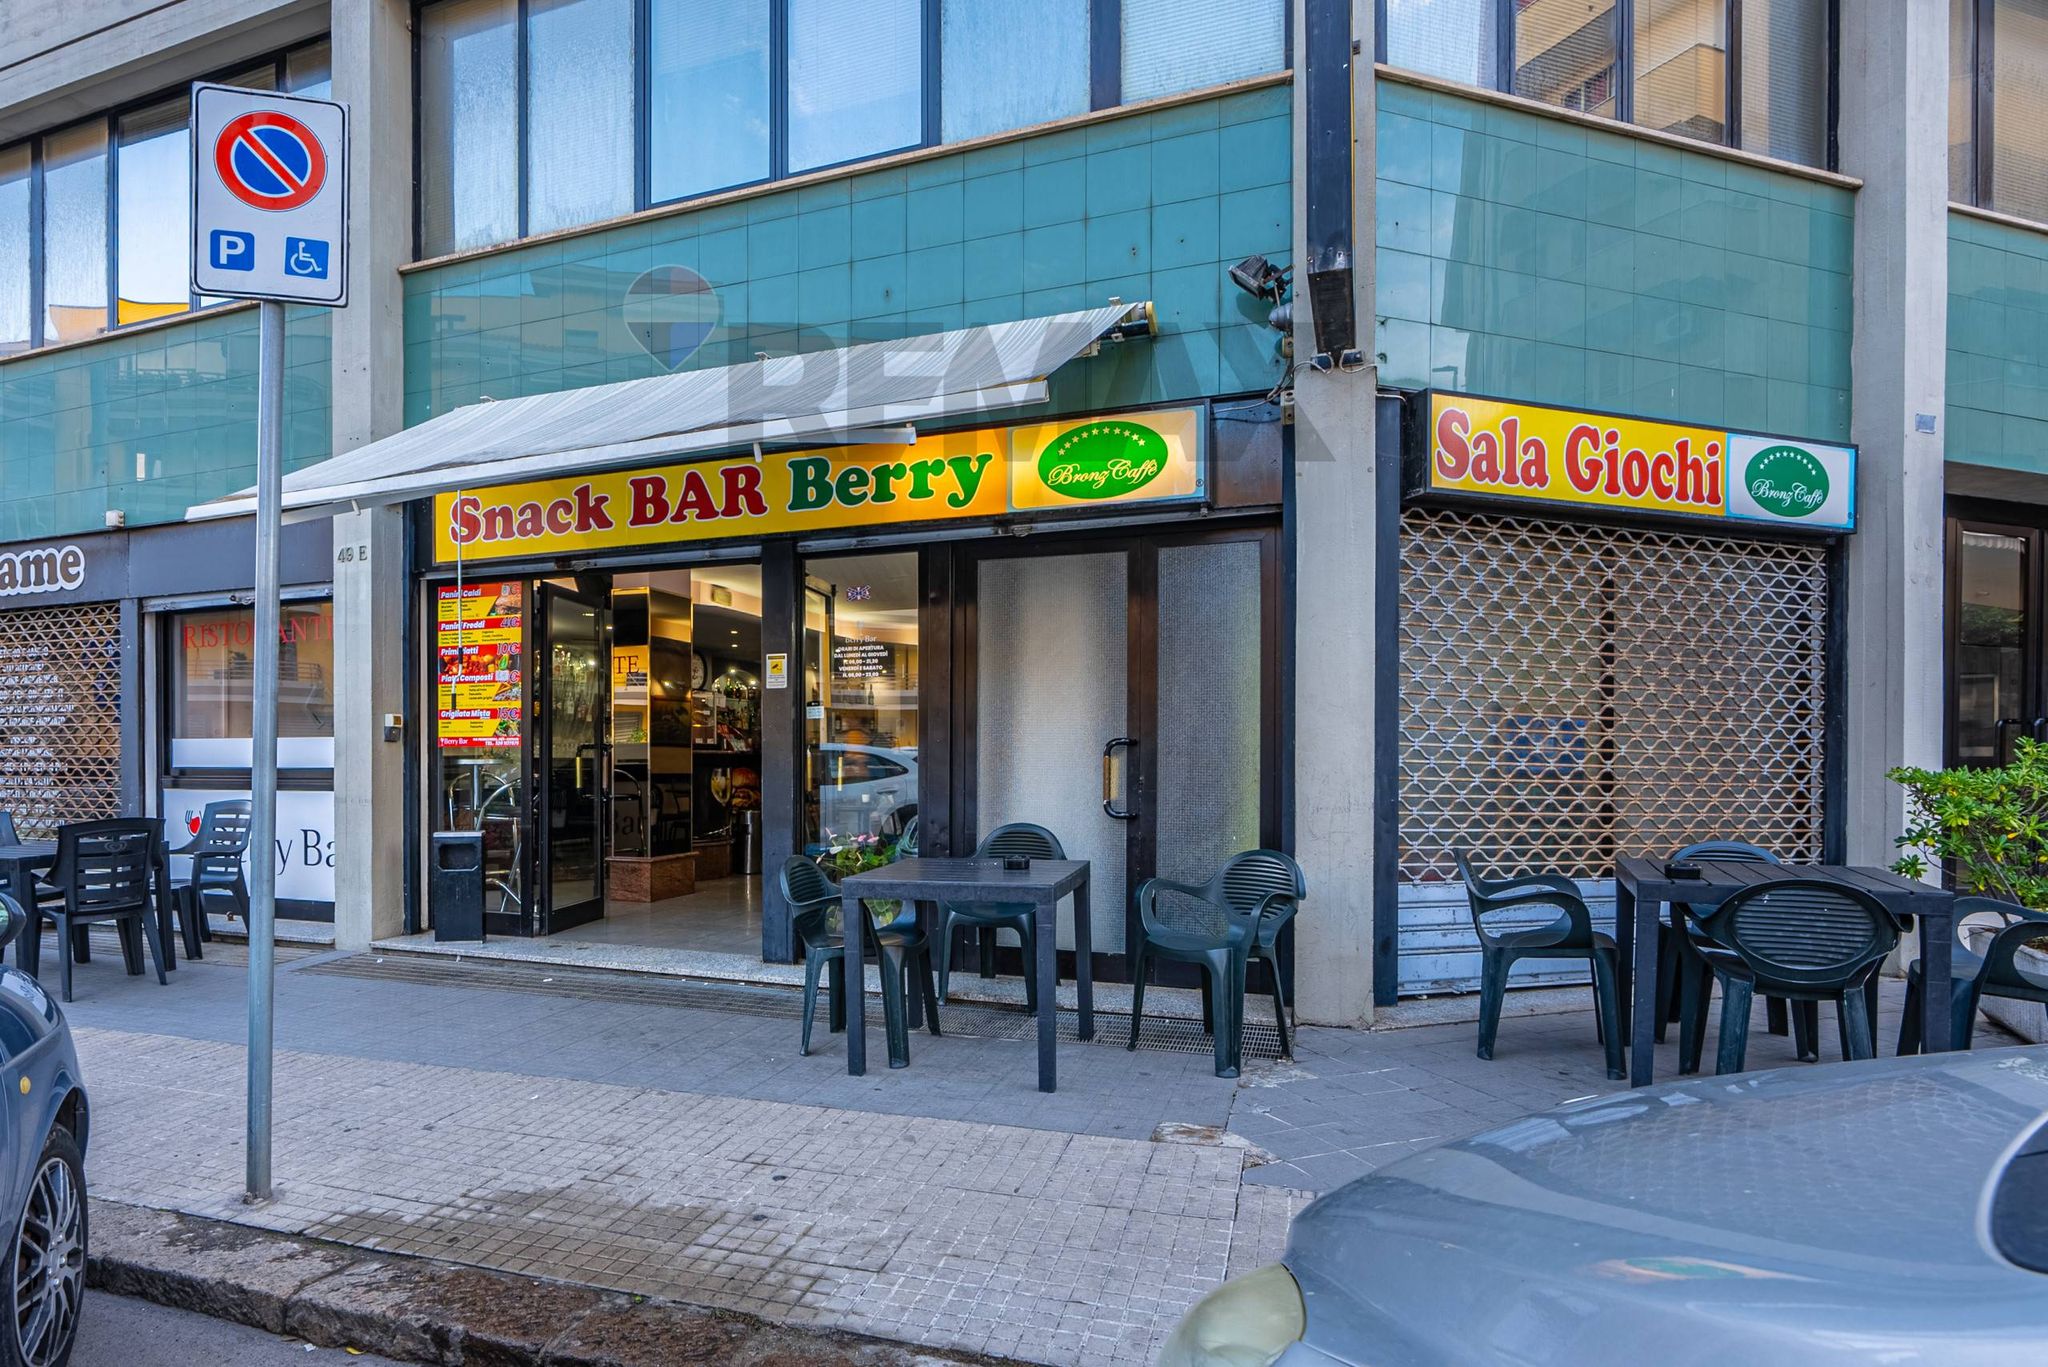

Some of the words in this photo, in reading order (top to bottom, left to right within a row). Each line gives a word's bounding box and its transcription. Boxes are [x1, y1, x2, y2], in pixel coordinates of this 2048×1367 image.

[219, 235, 245, 264] P
[1434, 407, 1549, 489] Sala
[1565, 424, 1722, 507] Giochi
[1047, 463, 1109, 489] Bronz
[450, 483, 615, 544] Snack
[628, 464, 769, 528] BAR
[787, 453, 993, 511] Berry
[1751, 478, 1793, 507] Bronz
[337, 546, 354, 563] 49
[359, 545, 368, 561] E
[463, 588, 482, 597] Caldi
[184, 614, 332, 648] RISTOANT
[463, 620, 486, 629] Freddi
[459, 646, 479, 655] iatti
[460, 673, 494, 683] Composti
[441, 709, 471, 719] Grigliata
[301, 828, 335, 868] Ba
